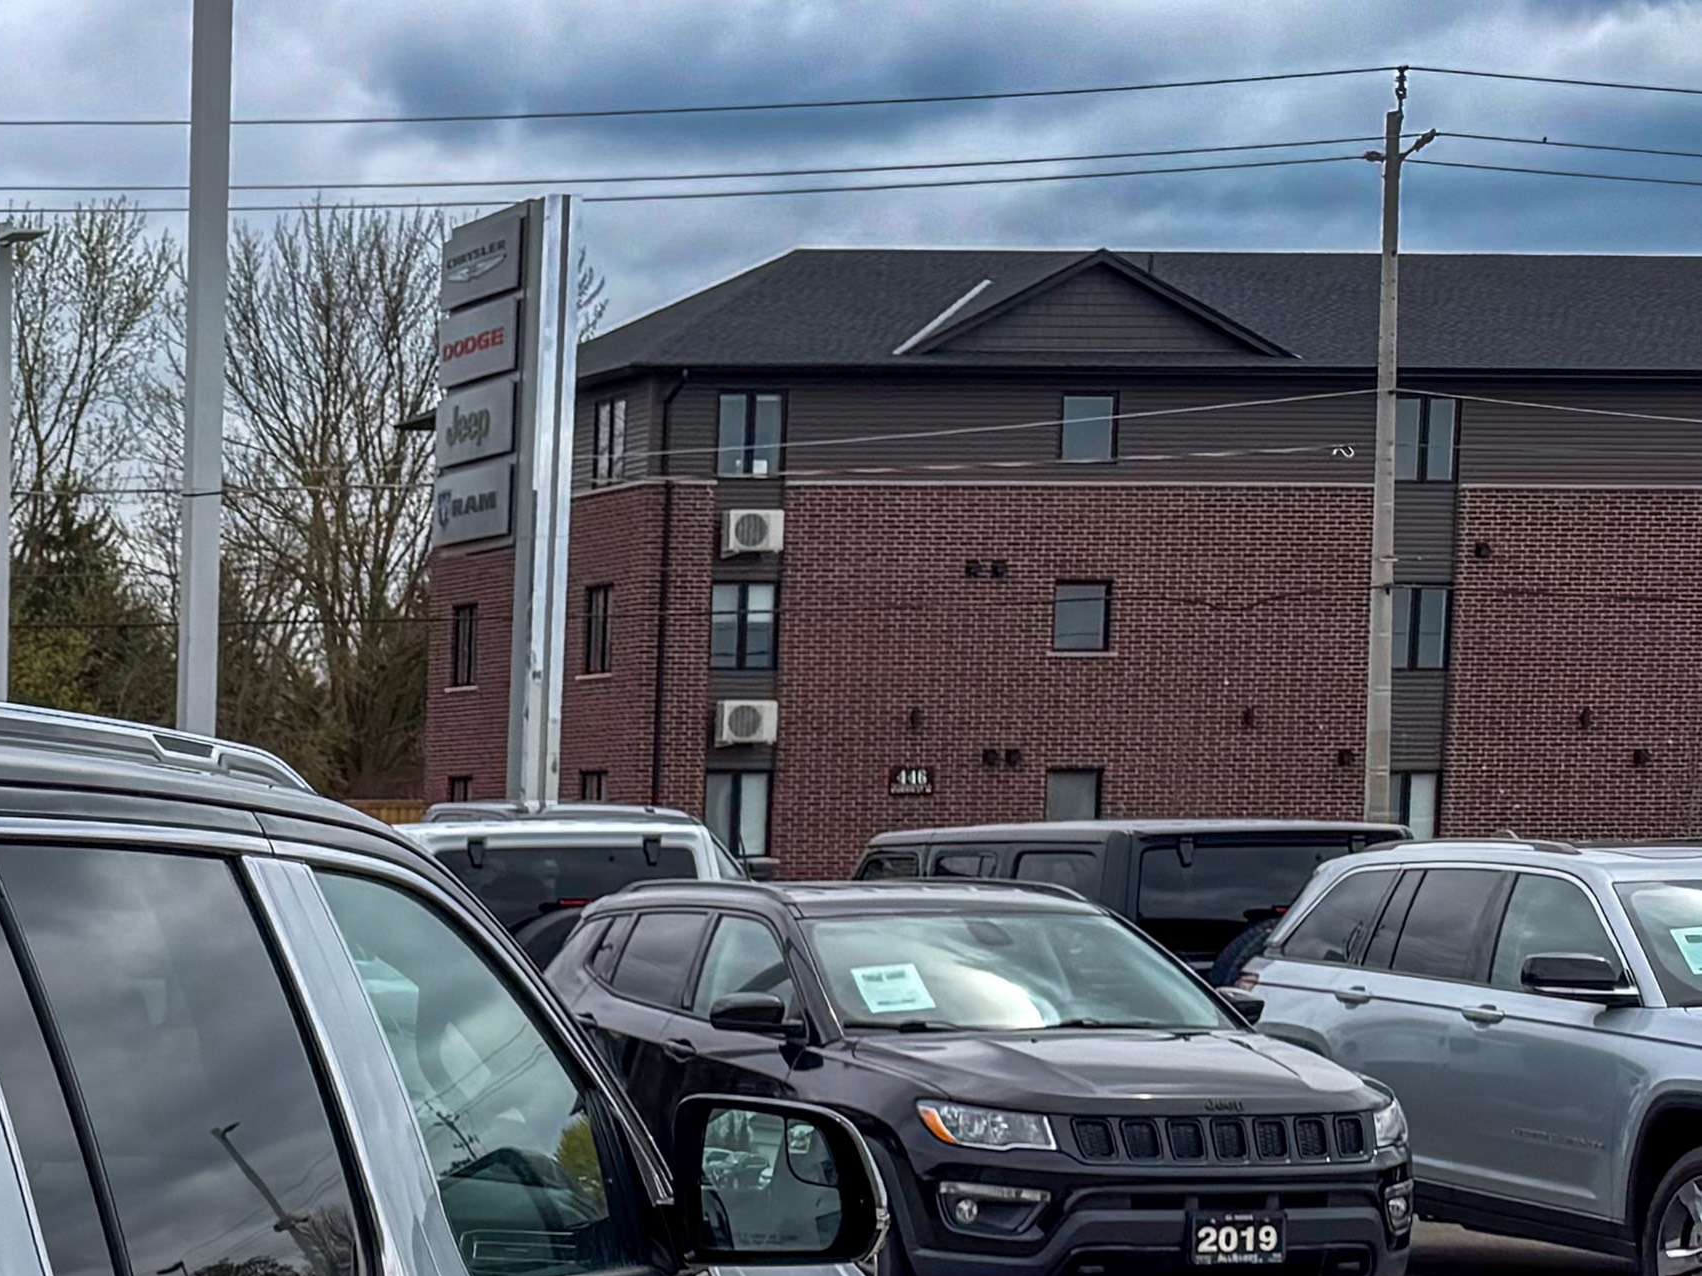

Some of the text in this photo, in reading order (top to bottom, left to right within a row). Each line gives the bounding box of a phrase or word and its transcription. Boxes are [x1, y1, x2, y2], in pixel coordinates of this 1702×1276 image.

[442, 326, 504, 362] DODGE
[447, 405, 490, 447] Jeep
[452, 490, 496, 518] RAM
[1197, 1224, 1278, 1253] 2019
